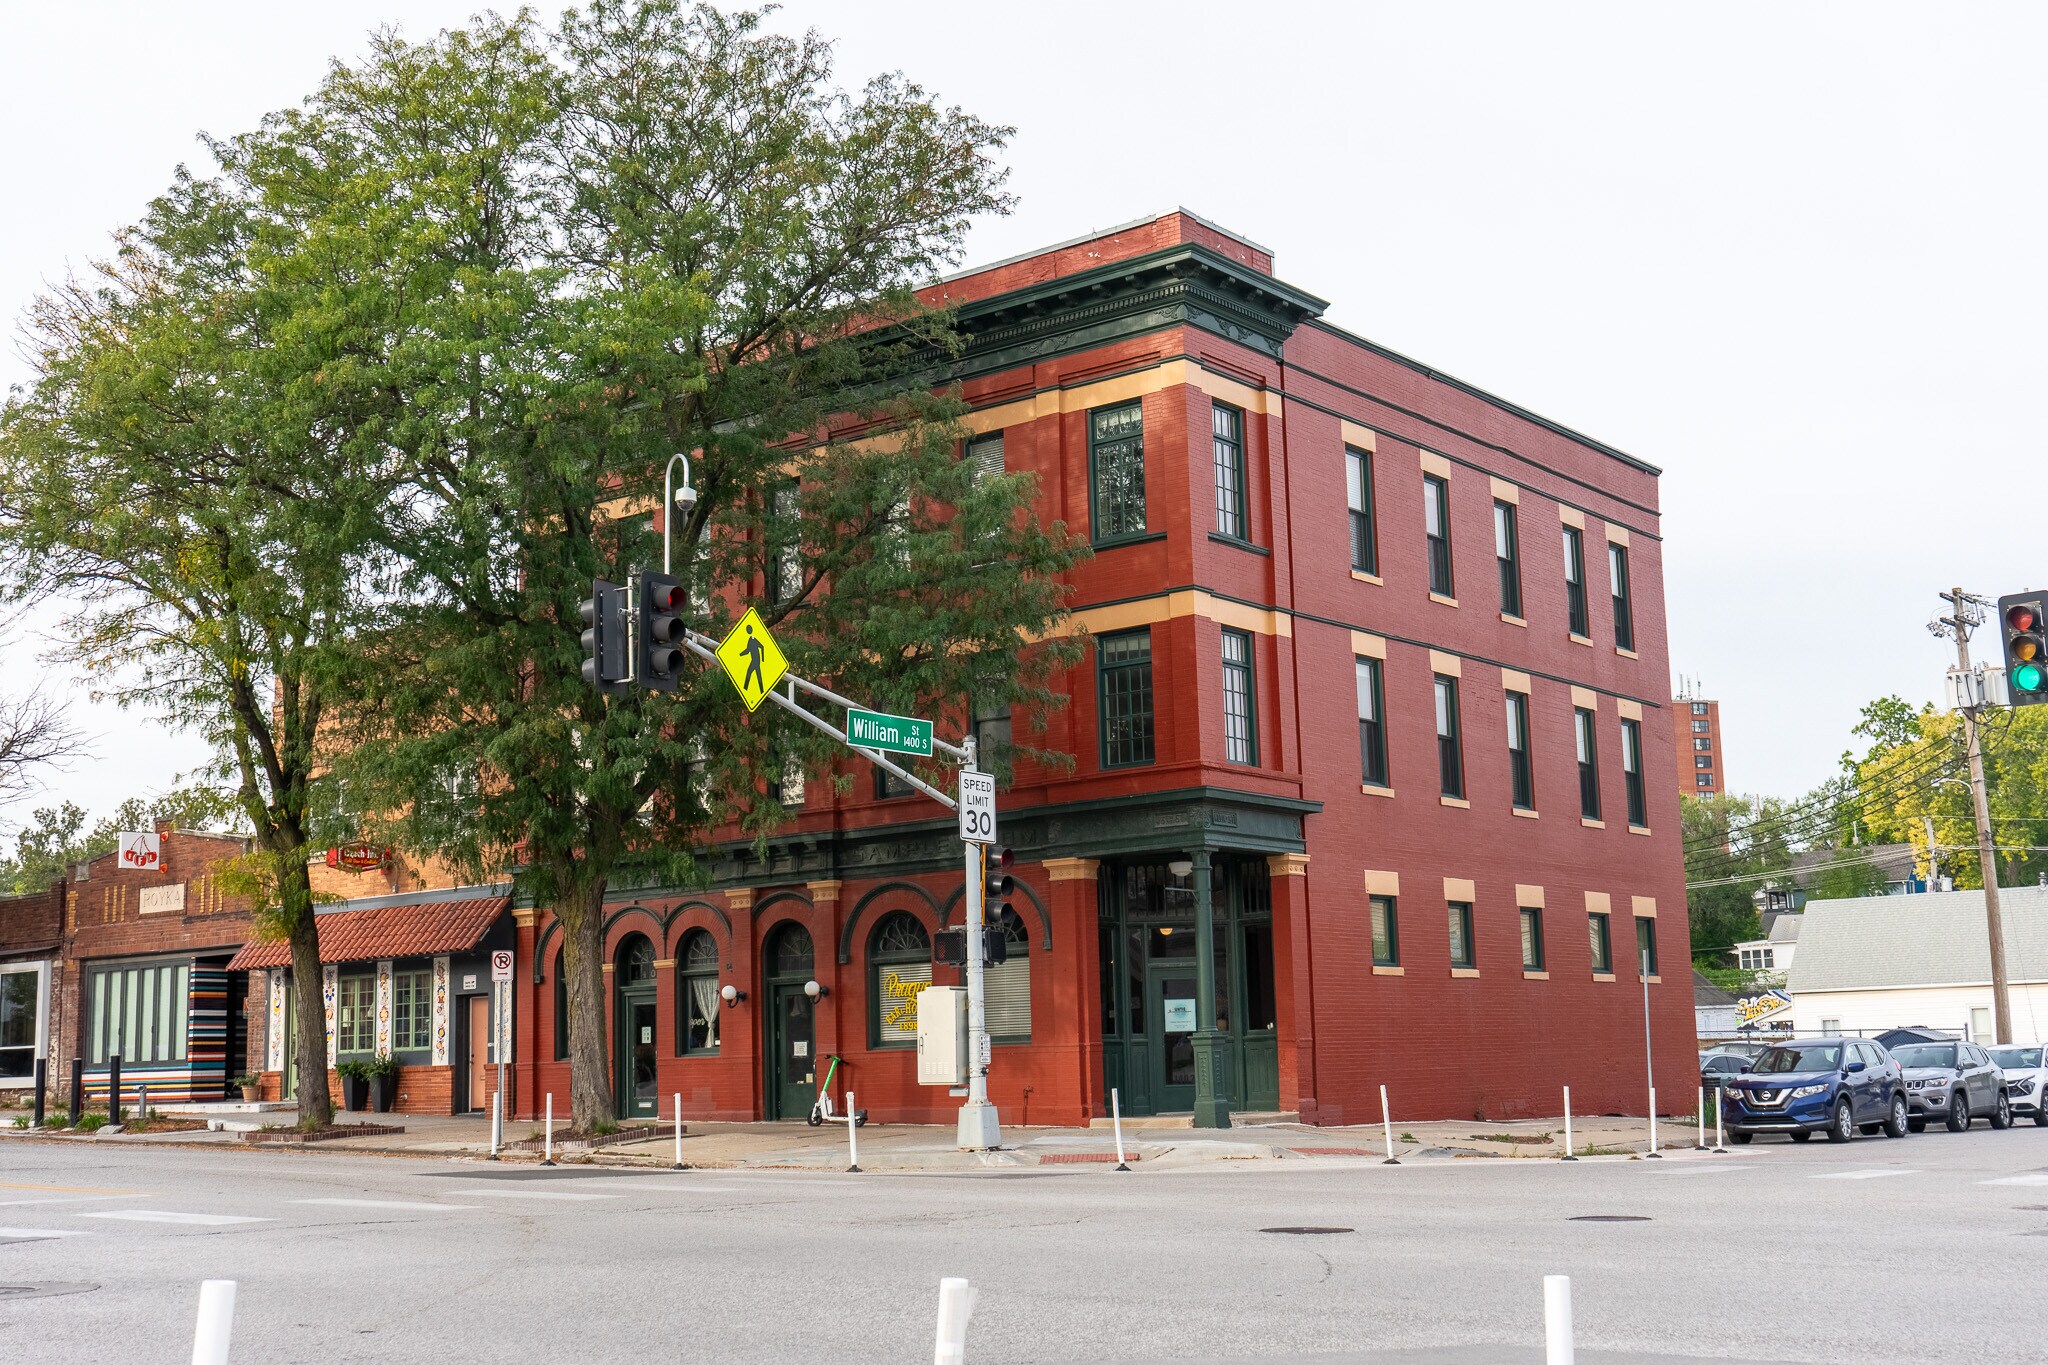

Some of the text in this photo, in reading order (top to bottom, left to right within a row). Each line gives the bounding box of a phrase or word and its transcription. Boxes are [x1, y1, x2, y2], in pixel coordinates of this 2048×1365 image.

[853, 717, 899, 744] William
[911, 725, 920, 735] St
[903, 736, 928, 749] 1400 S
[963, 778, 992, 793] SPEED
[966, 795, 989, 808] LIMIT
[965, 809, 991, 836] 30
[886, 1006, 901, 1025] BAR
